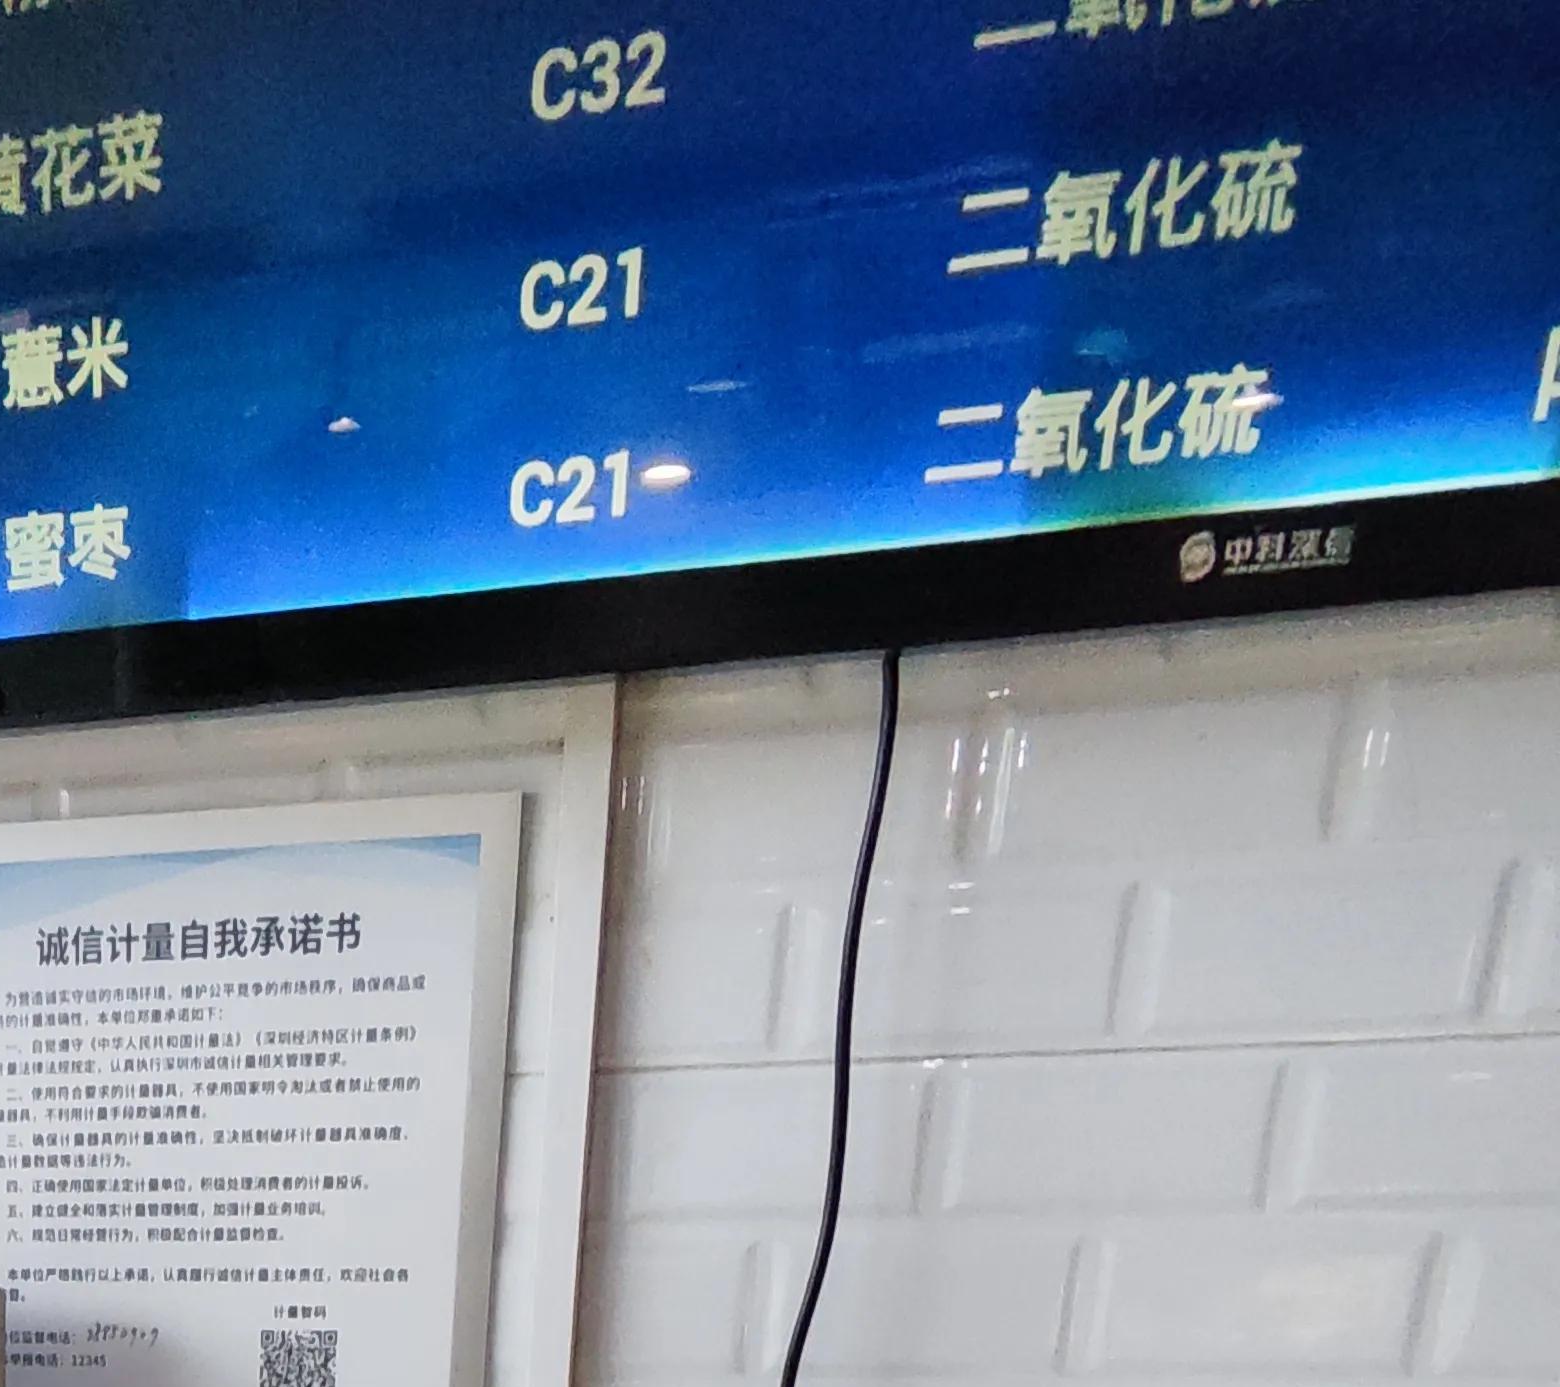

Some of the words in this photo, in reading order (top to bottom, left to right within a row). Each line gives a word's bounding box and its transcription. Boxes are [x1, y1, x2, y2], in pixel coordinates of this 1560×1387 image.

[530, 29, 668, 122] C32
[947, 138, 1305, 275] 二氧化硫
[519, 247, 645, 331] C21
[0, 316, 130, 410] 薏米
[923, 363, 1272, 484] 二氧化硫
[508, 449, 632, 529] C21
[5, 502, 132, 593] 蜜枣
[36, 911, 362, 967] 诚信计量自我承诺书
